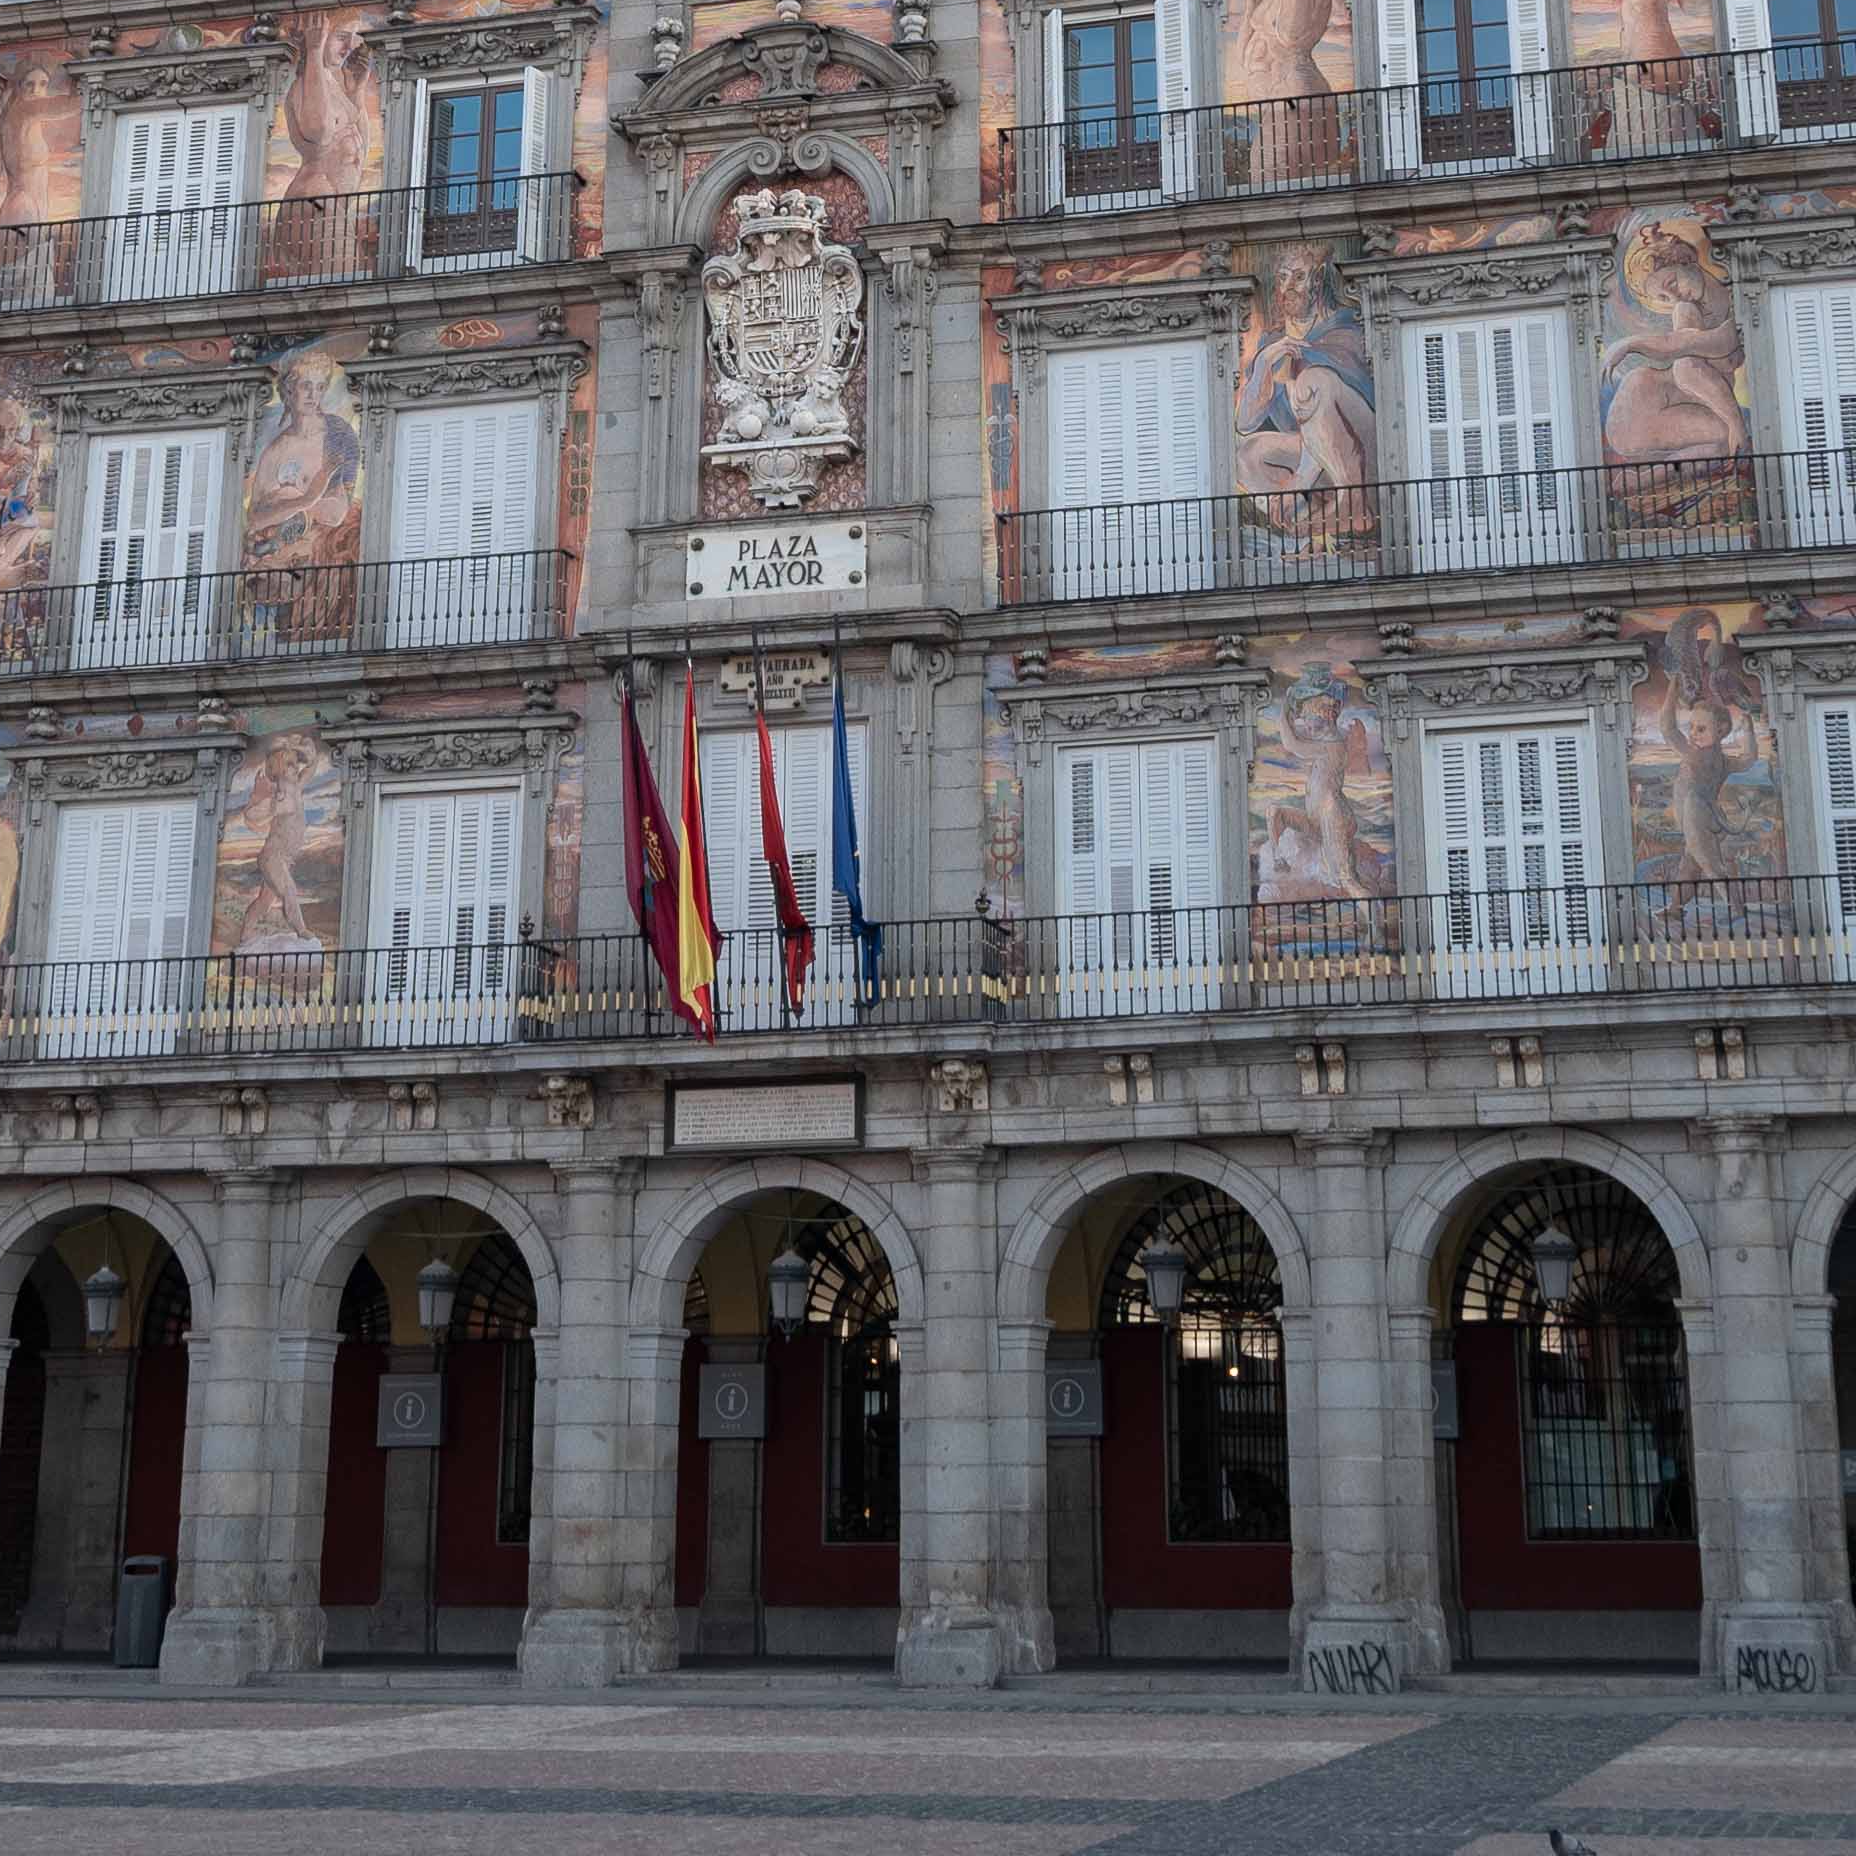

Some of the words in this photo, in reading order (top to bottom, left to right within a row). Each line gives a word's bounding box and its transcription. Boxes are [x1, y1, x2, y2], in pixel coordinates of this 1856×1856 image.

[738, 535, 818, 561] PLAZA
[727, 560, 824, 591] MAYOR
[736, 657, 815, 674] REAURADA
[766, 674, 784, 686] AÑO
